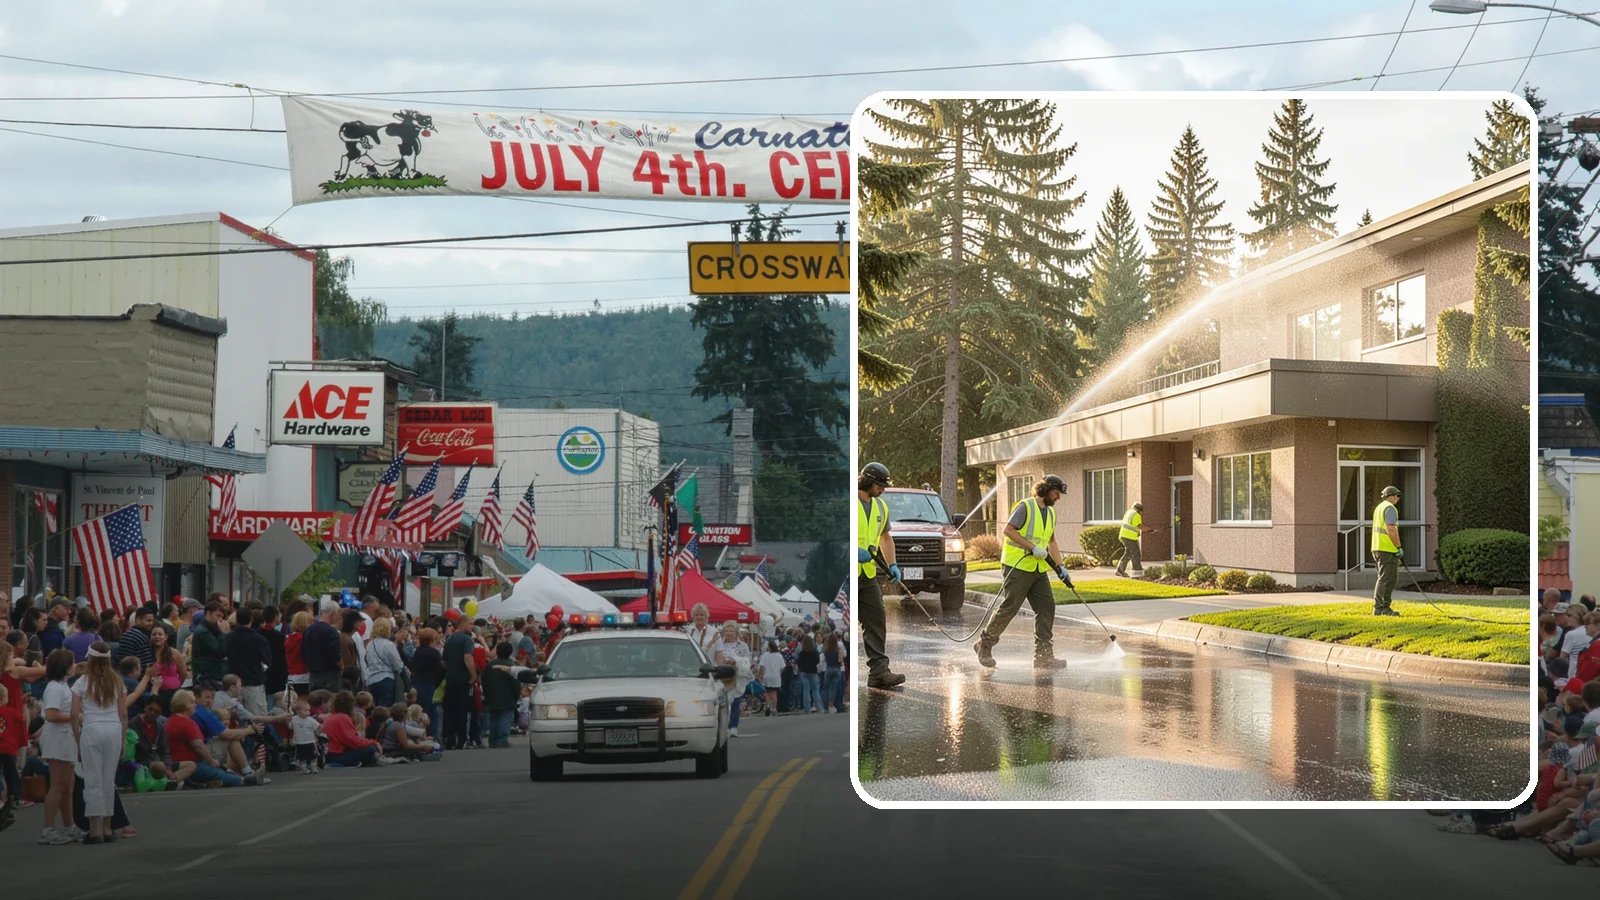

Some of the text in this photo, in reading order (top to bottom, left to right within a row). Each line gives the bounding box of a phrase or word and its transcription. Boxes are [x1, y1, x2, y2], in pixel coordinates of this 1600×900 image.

[481, 141, 605, 192] JULY
[632, 150, 746, 198] 4th.
[697, 254, 850, 280] CROSSWA
[282, 380, 374, 420] ACE
[405, 409, 485, 422] CEDAR LOG
[283, 421, 371, 437] Hardware
[416, 428, 477, 447] Coca-Cola
[83, 485, 155, 495] St. Vincent de Paul
[688, 526, 741, 535] CRNATION
[699, 535, 730, 543] GLASS
